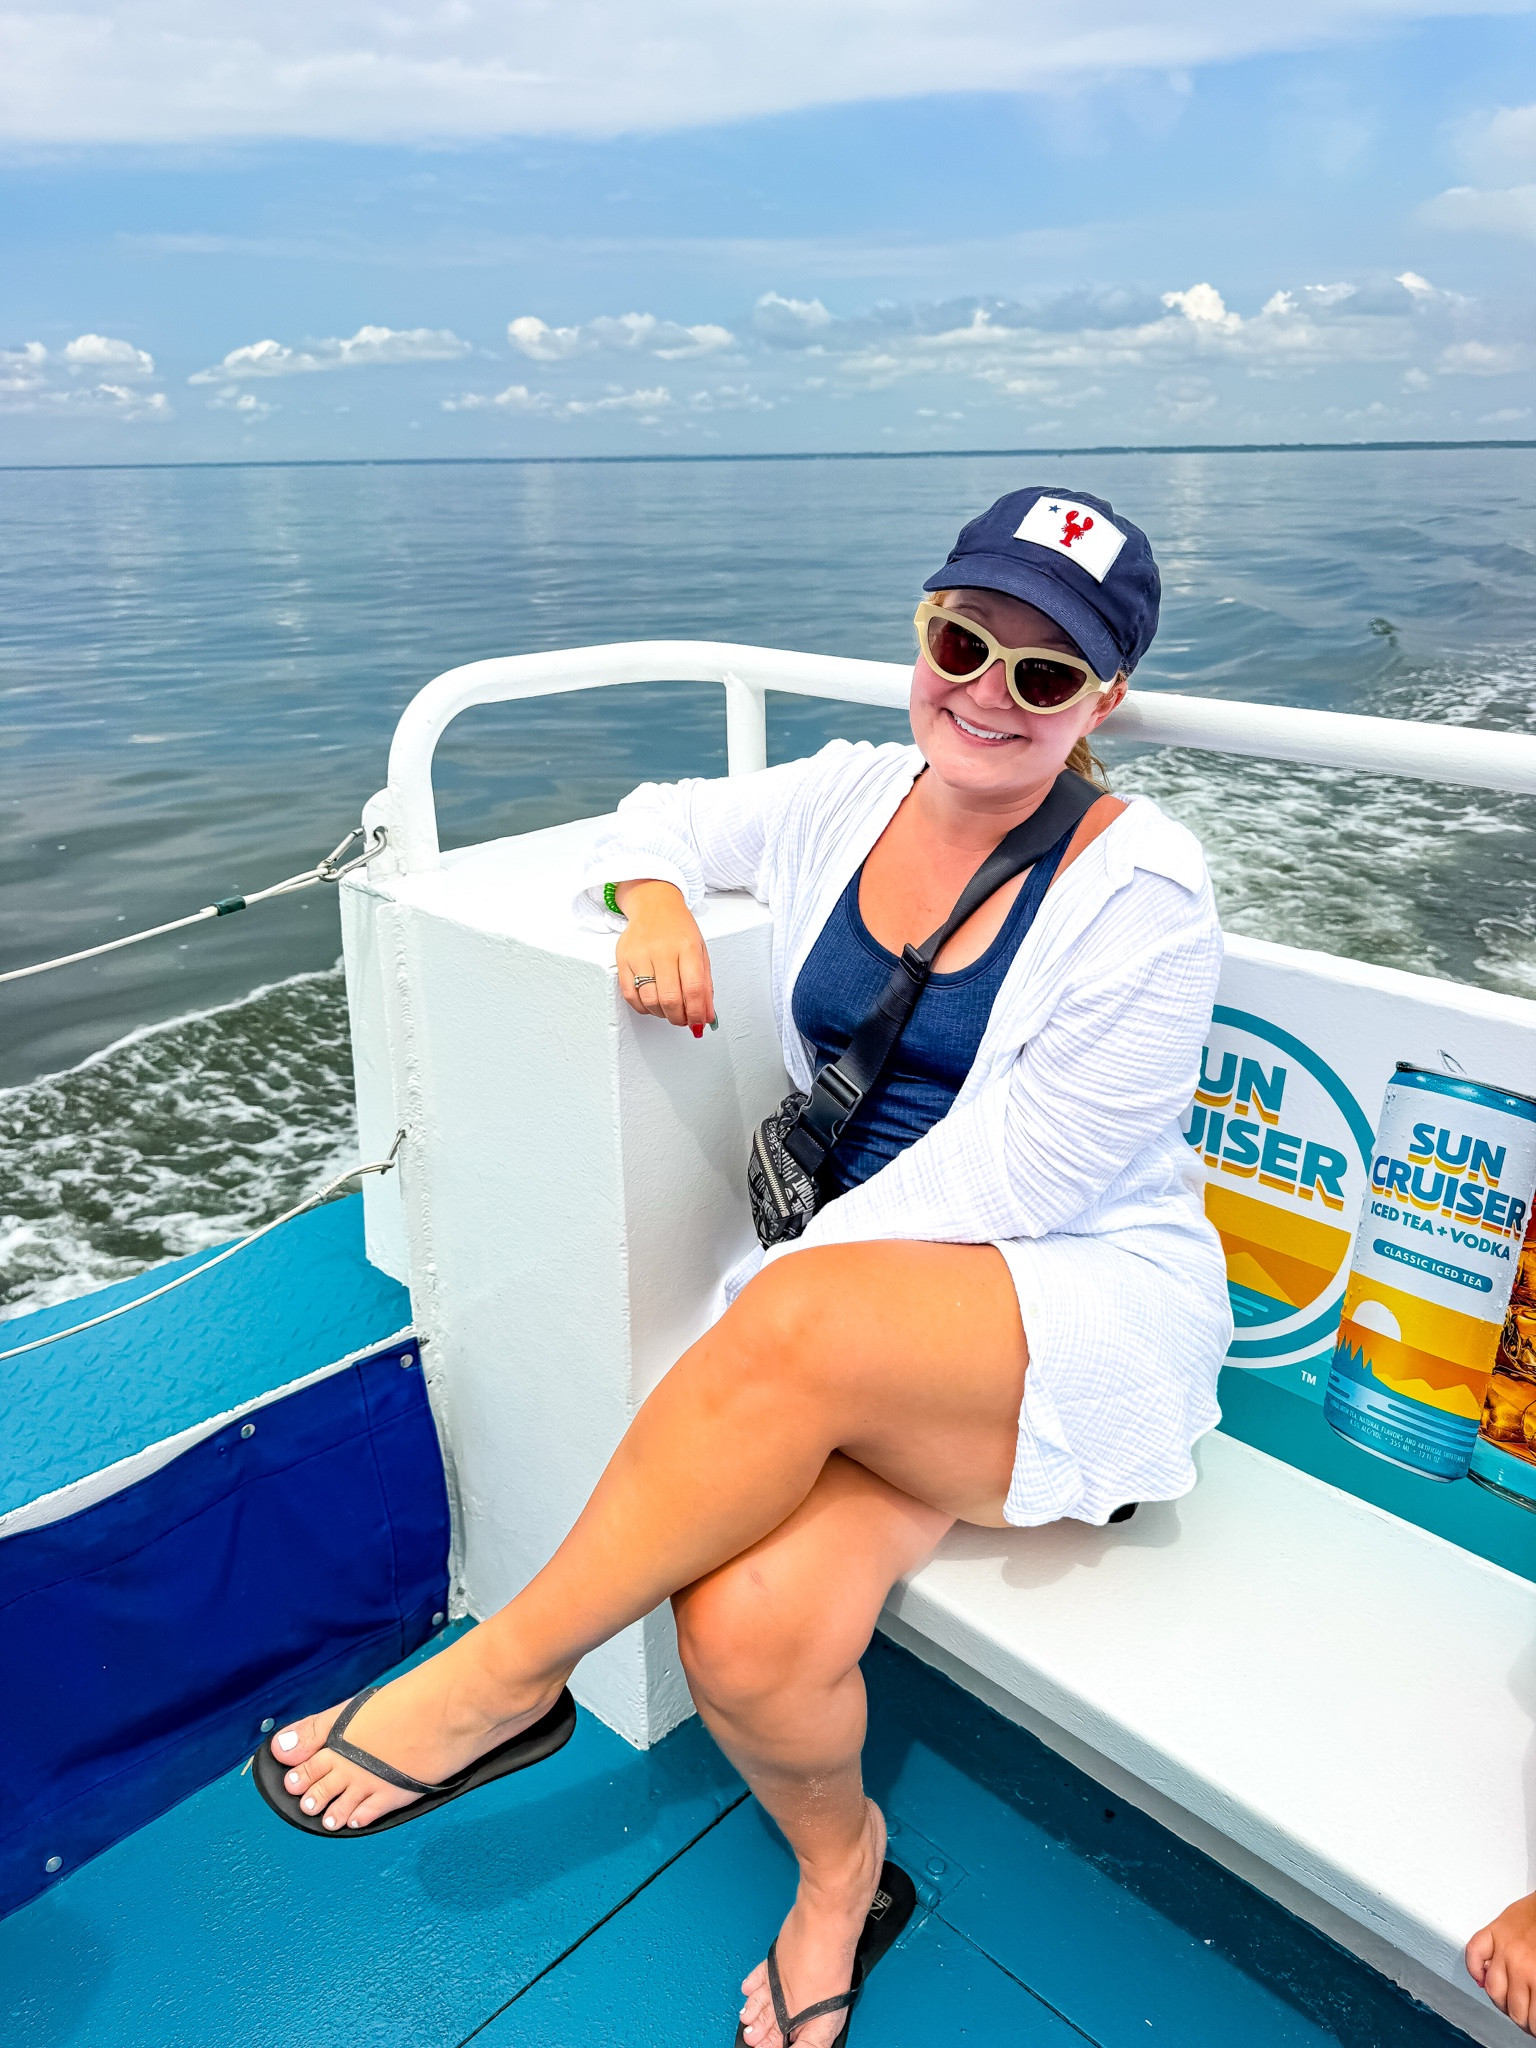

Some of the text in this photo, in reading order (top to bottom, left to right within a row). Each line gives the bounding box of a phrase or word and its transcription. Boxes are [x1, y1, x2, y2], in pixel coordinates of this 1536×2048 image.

[1198, 1045, 1287, 1113] UN
[1182, 1104, 1349, 1198] UISER
[1408, 1122, 1507, 1179] SUN
[1372, 1155, 1527, 1232] CRUISER
[1370, 1200, 1400, 1222] ICED
[1402, 1211, 1434, 1236] TEA
[1450, 1227, 1511, 1261] VODKA
[1383, 1245, 1483, 1288] CLASSIC ICED TEA
[1301, 1370, 1317, 1386] TM
[1381, 1426, 1404, 1442] FLAVORS
[1404, 1437, 1416, 1447] AND
